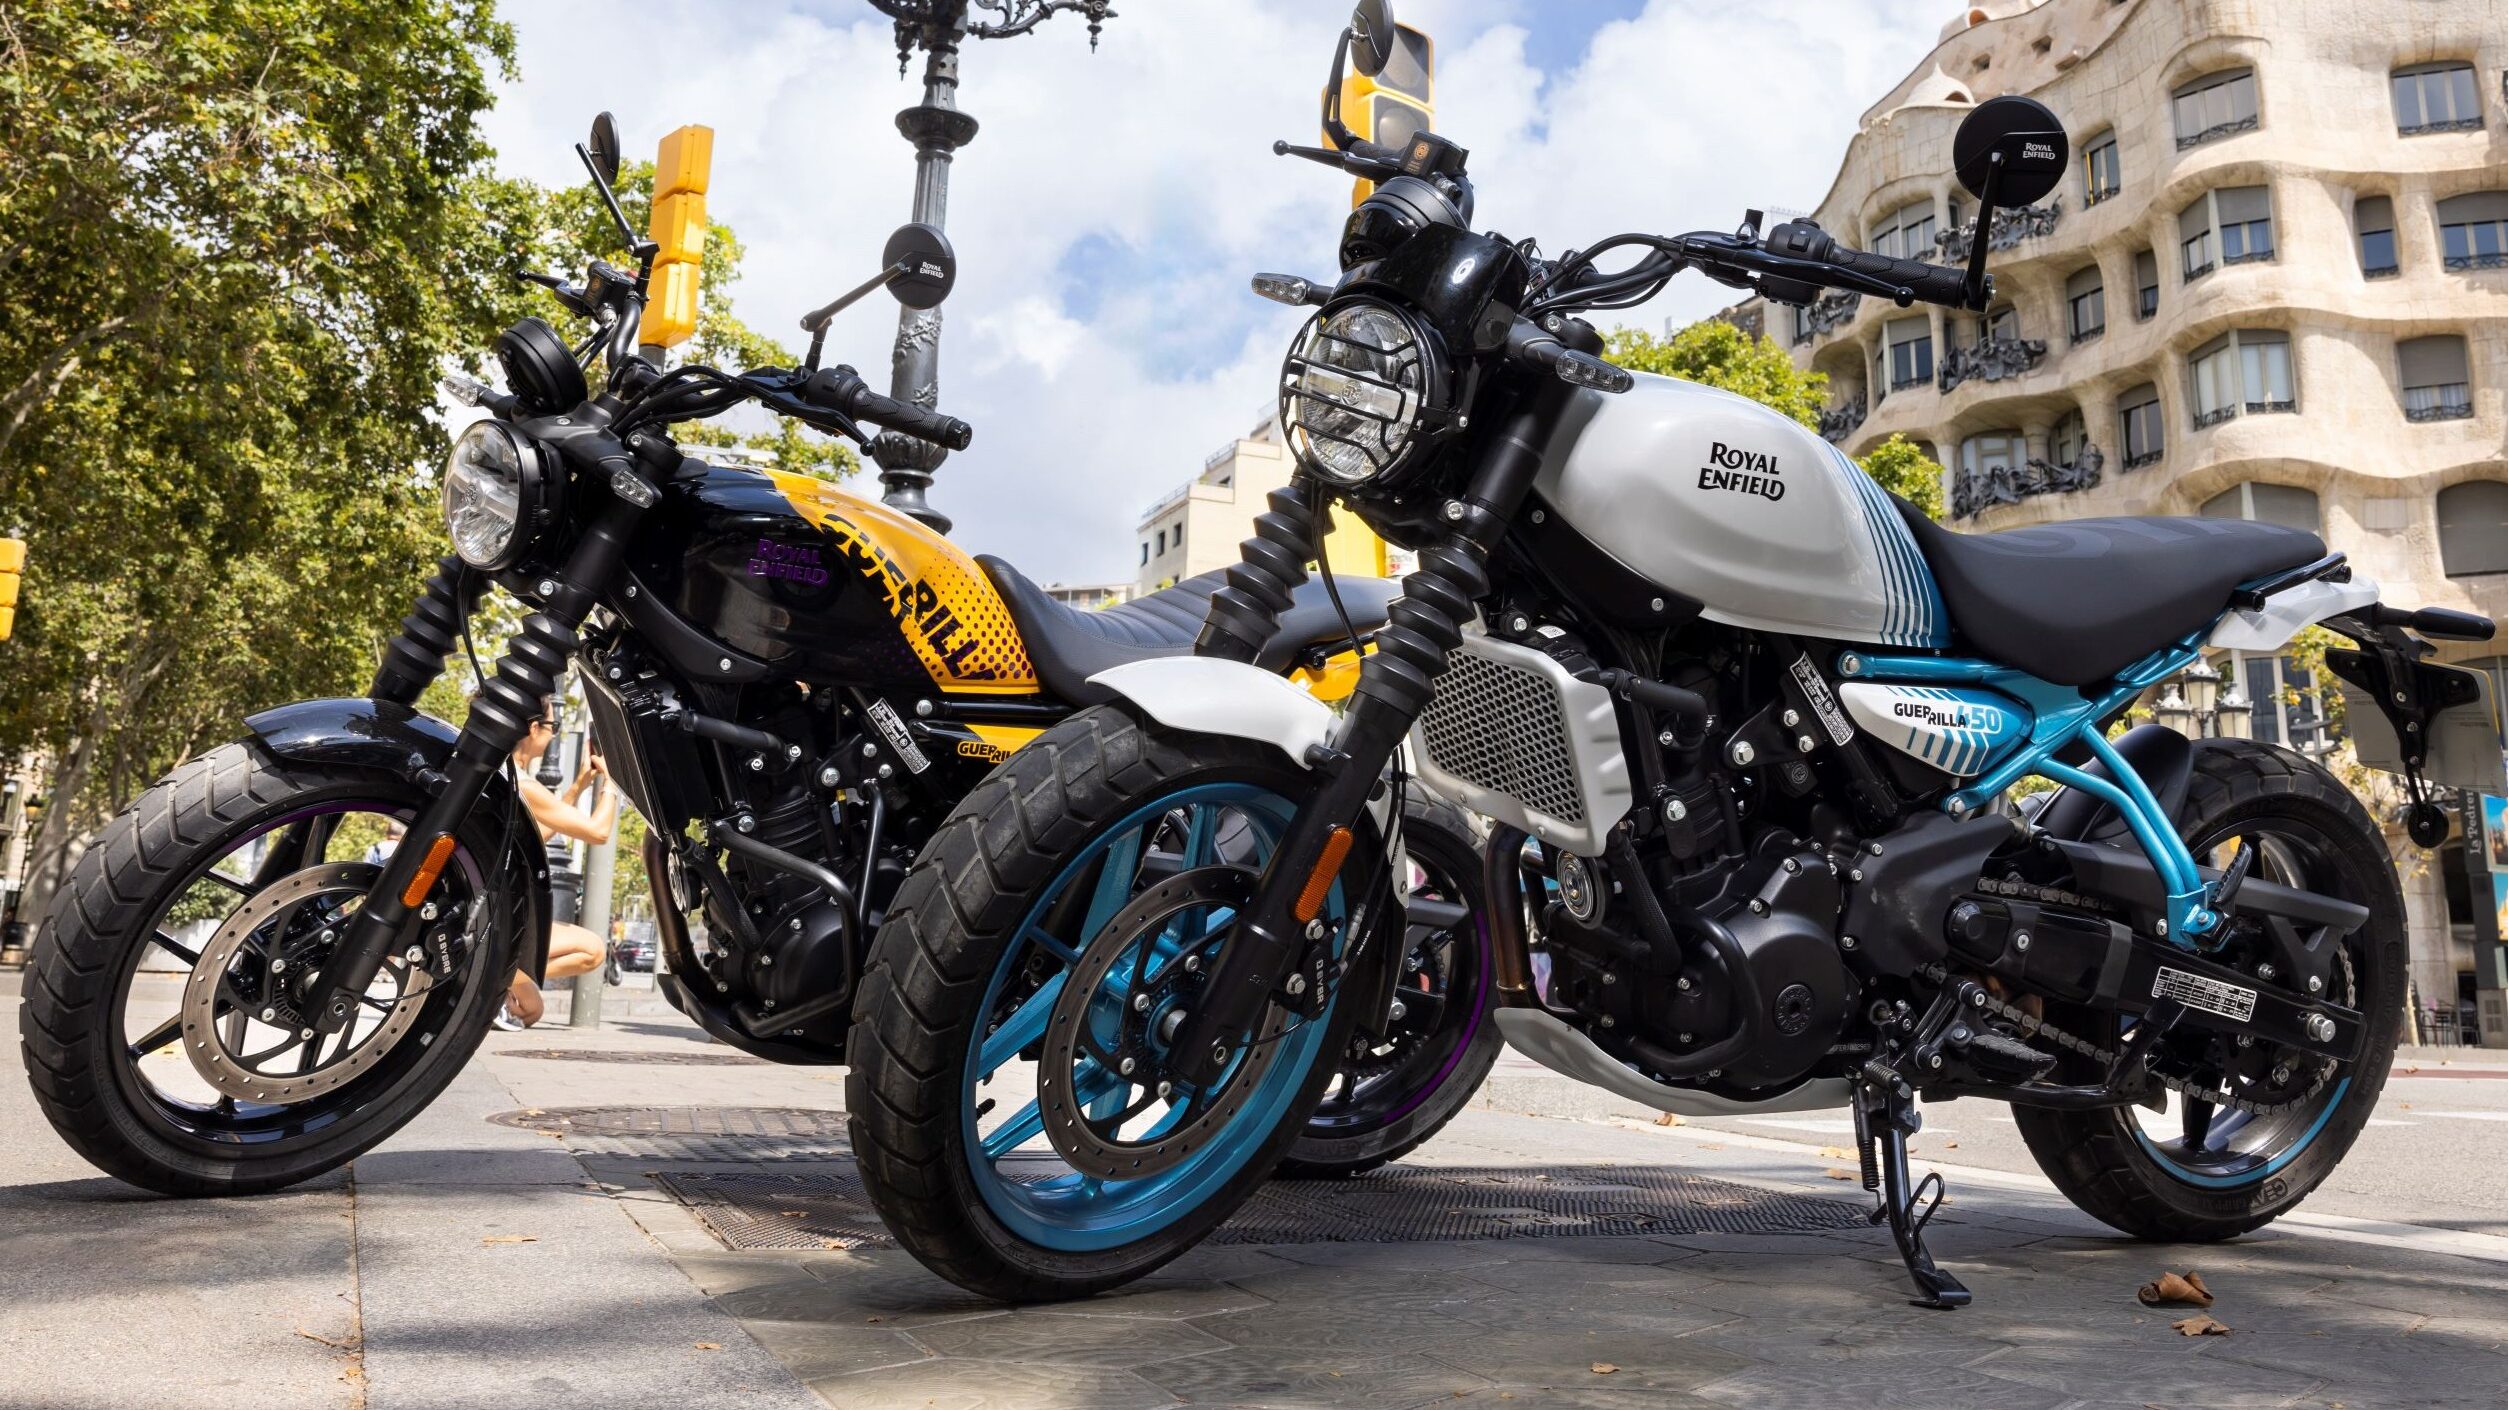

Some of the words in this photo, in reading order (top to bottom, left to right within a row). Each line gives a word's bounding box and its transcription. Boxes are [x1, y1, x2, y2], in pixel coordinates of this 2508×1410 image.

[2022, 150, 2056, 160] ENFIELD
[2025, 142, 2052, 152] ROYAL
[919, 267, 944, 279] ENFIELD
[922, 262, 942, 272] ROYAL
[1709, 441, 1780, 475] ROYAL
[1697, 467, 1786, 502] ENFIELD
[757, 539, 821, 564] ROYAL
[747, 558, 829, 588] ENFIELD
[1894, 702, 1967, 728] GUERRILLA
[1955, 705, 2000, 733] 450
[2464, 791, 2479, 839] Pedrer
[439, 942, 452, 974] BYBRE
